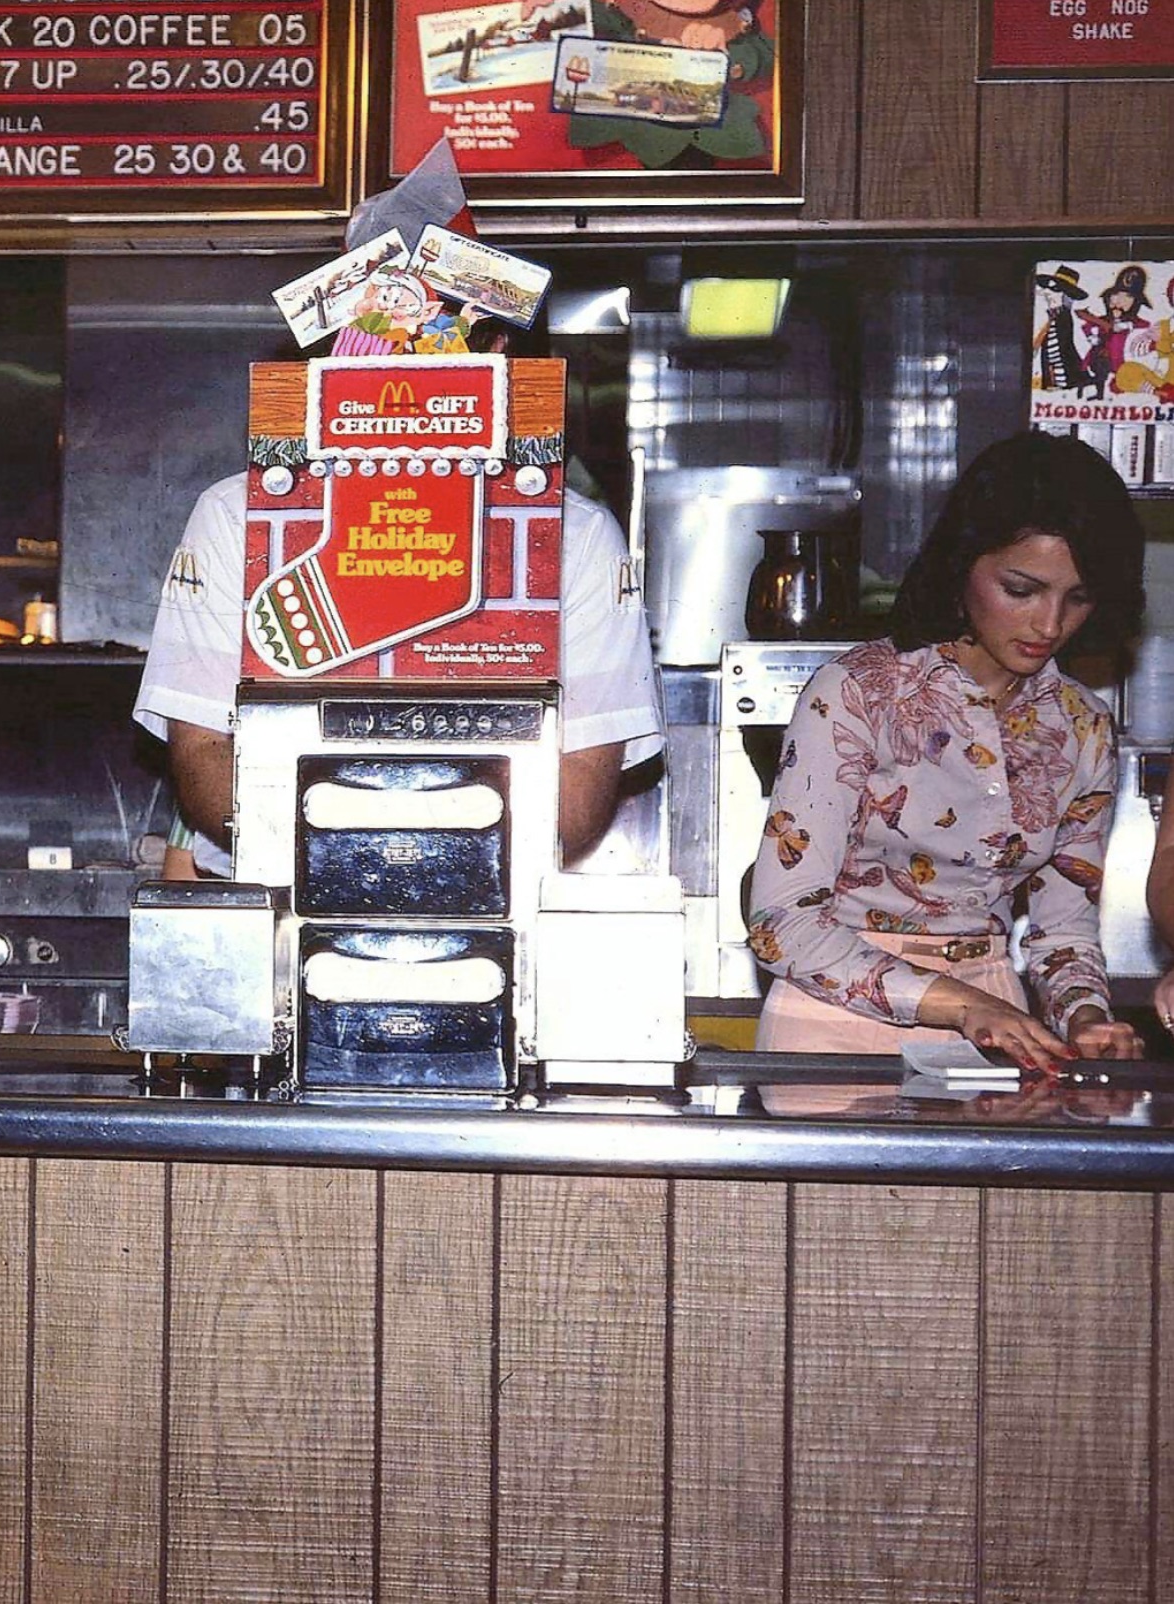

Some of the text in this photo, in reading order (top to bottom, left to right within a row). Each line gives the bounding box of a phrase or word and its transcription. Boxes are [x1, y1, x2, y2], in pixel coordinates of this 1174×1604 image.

[1050, 0, 1148, 16] EGG NOG
[33, 16, 75, 48] 20
[89, 14, 231, 46] COFFEE
[259, 13, 306, 46] 05
[1072, 23, 1134, 40] SHAKE
[0, 60, 20, 89] 7
[32, 60, 77, 90] UP
[254, 101, 309, 132] .45
[113, 144, 156, 174] 25
[169, 143, 215, 175] 30
[222, 143, 246, 174] &
[259, 143, 306, 174] 40
[338, 400, 376, 415] Give
[426, 395, 478, 414] GIFT
[329, 416, 484, 435] CERTIFICATES
[384, 488, 417, 501] with
[369, 501, 431, 524] Free
[347, 526, 457, 553] Holiday
[336, 551, 465, 582] Envelope
